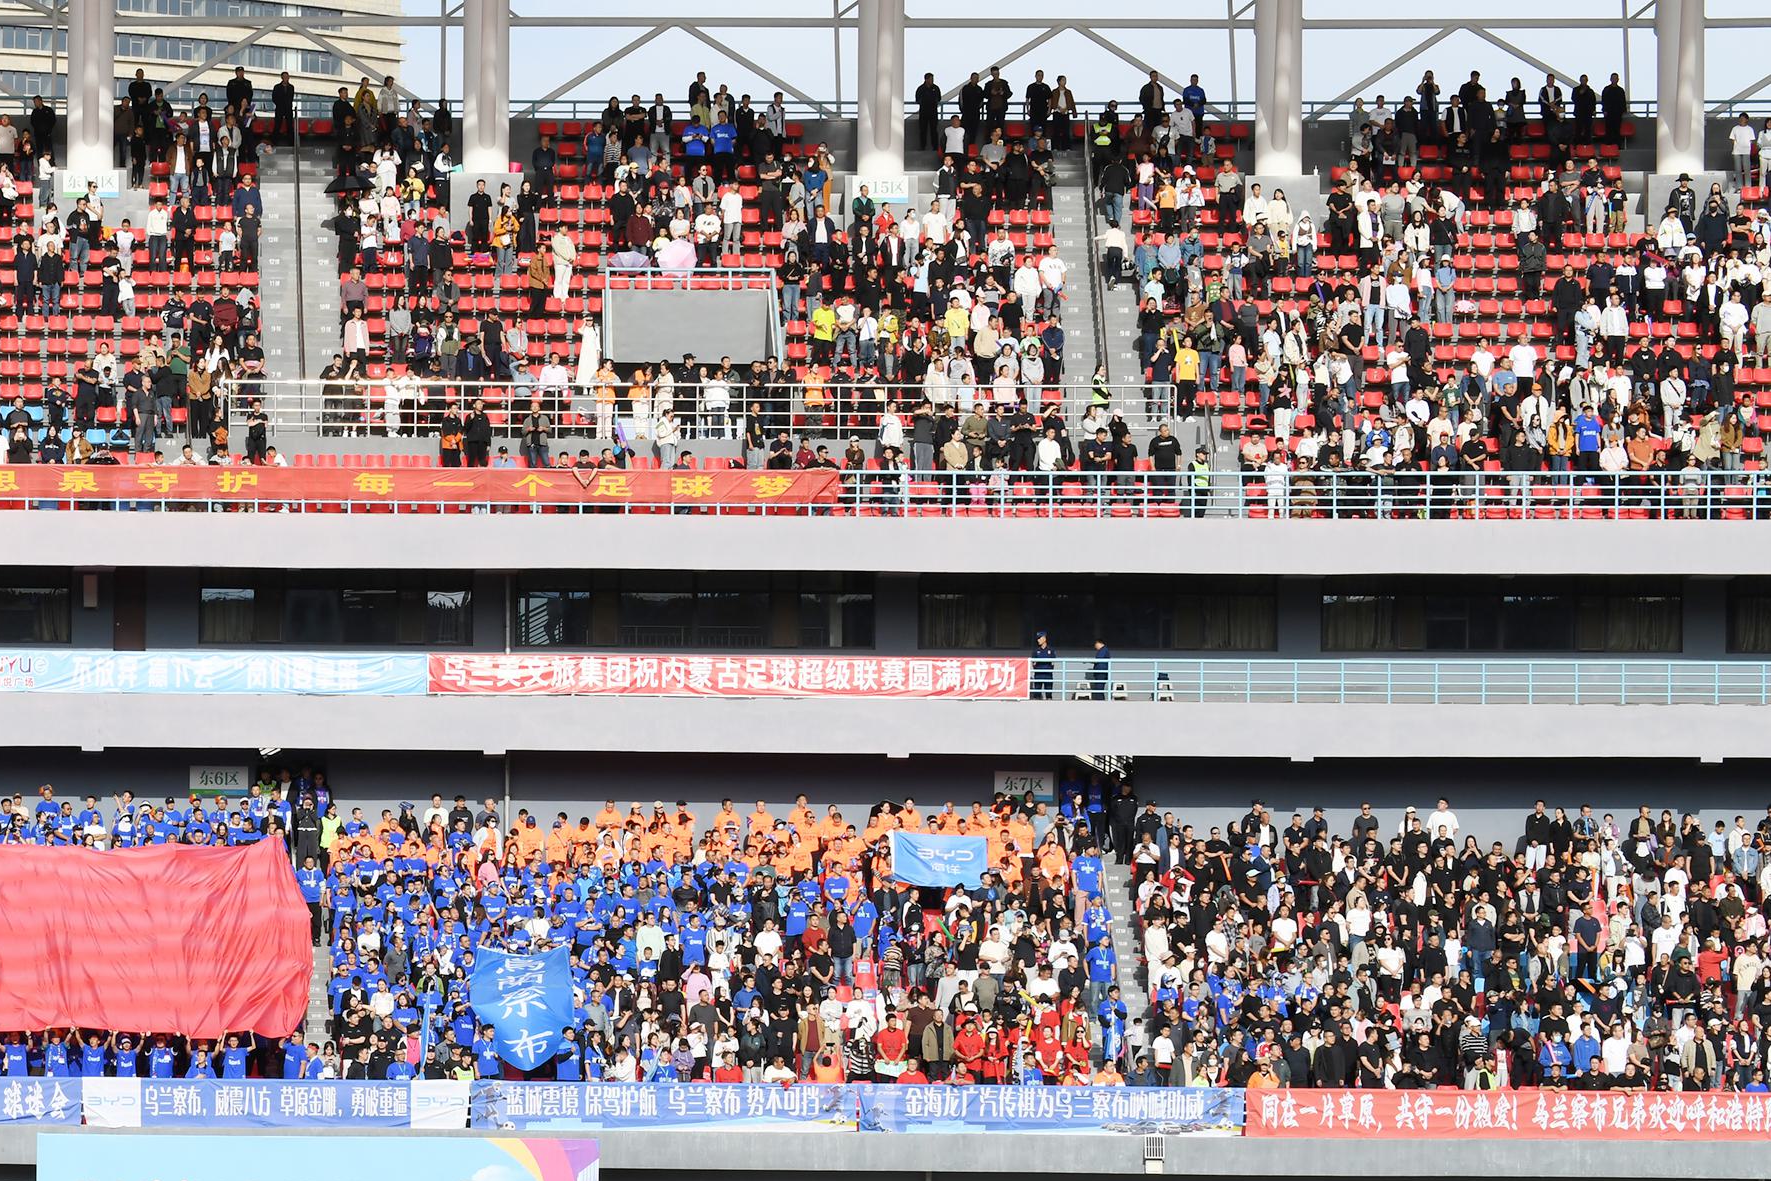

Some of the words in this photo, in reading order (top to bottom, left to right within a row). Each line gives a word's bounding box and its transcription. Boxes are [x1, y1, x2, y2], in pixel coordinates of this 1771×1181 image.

[353, 474, 793, 499] 每一个足球梦
[199, 770, 240, 786] 东6区
[1004, 775, 1045, 792] 东7区
[144, 1086, 271, 1118] 乌兰察布，威震八方
[584, 1086, 658, 1118] 保驾护航
[667, 1085, 742, 1118] 乌兰察布
[746, 1085, 821, 1118] 势不可挡
